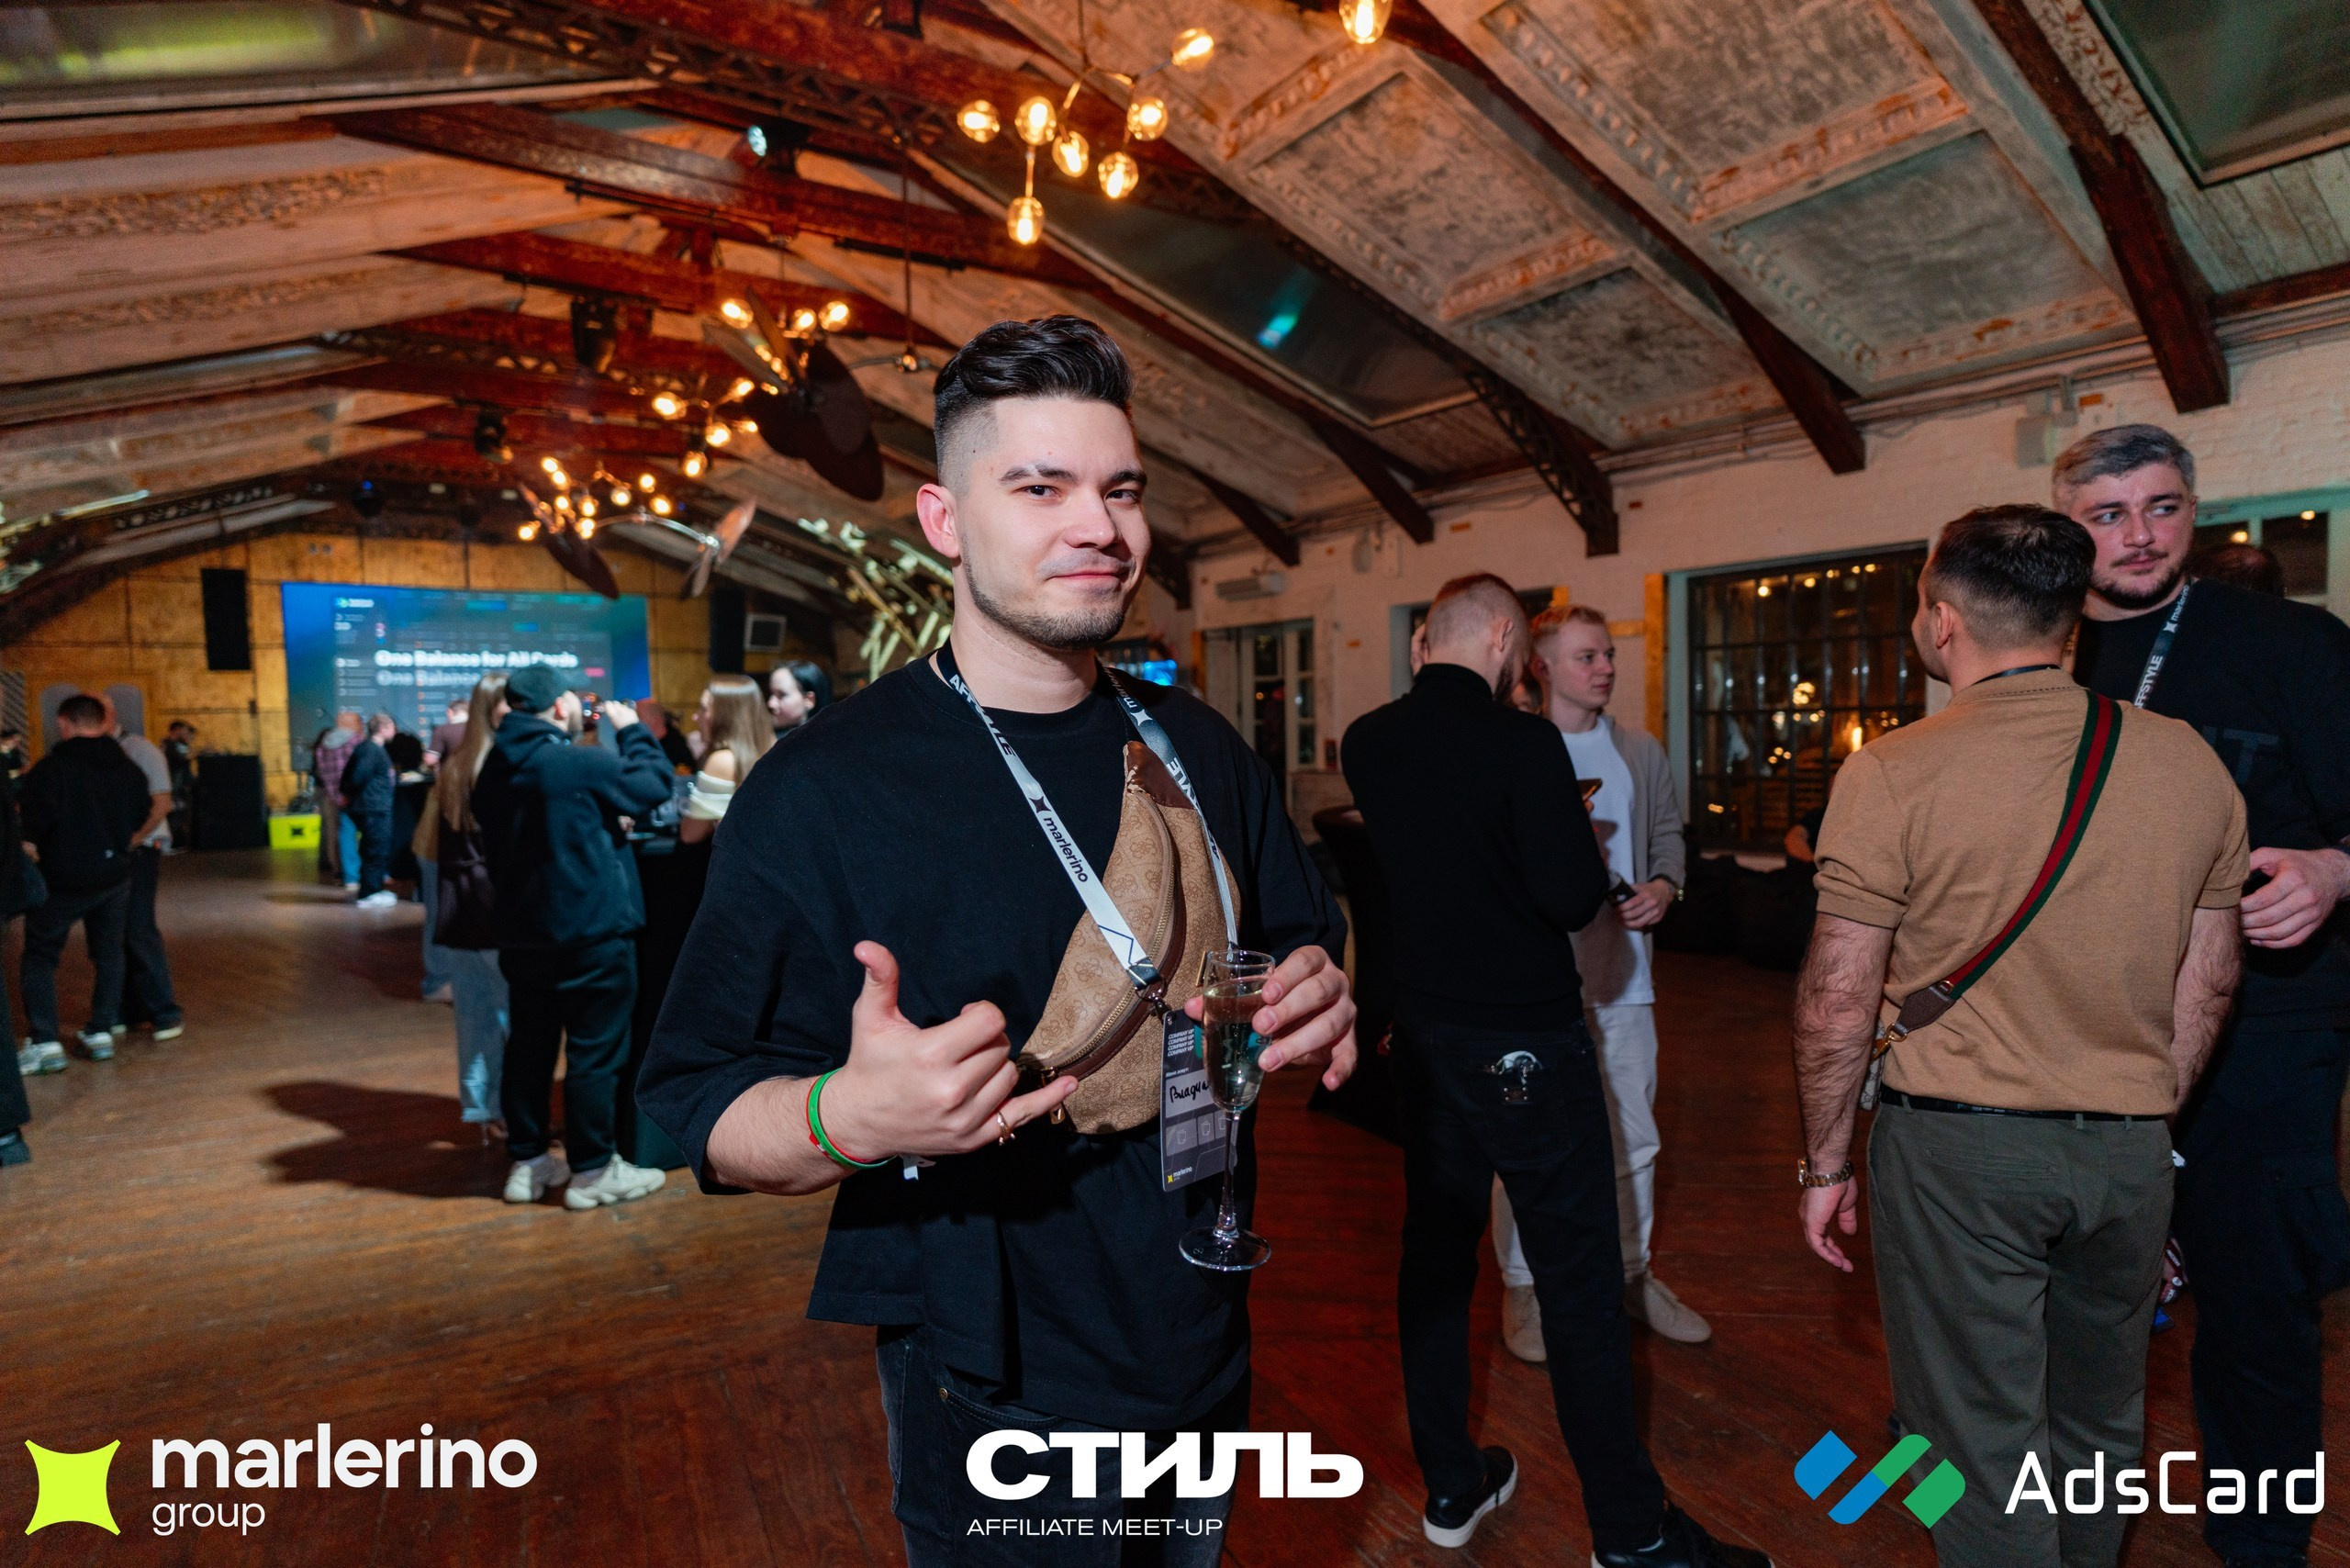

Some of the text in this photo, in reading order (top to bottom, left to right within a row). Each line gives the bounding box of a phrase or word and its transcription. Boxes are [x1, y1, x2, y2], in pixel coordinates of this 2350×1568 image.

[375, 650, 413, 666] One
[414, 650, 481, 667] Balance
[481, 650, 506, 667] for
[507, 651, 530, 667] All
[1043, 817, 1089, 883] marlerino
